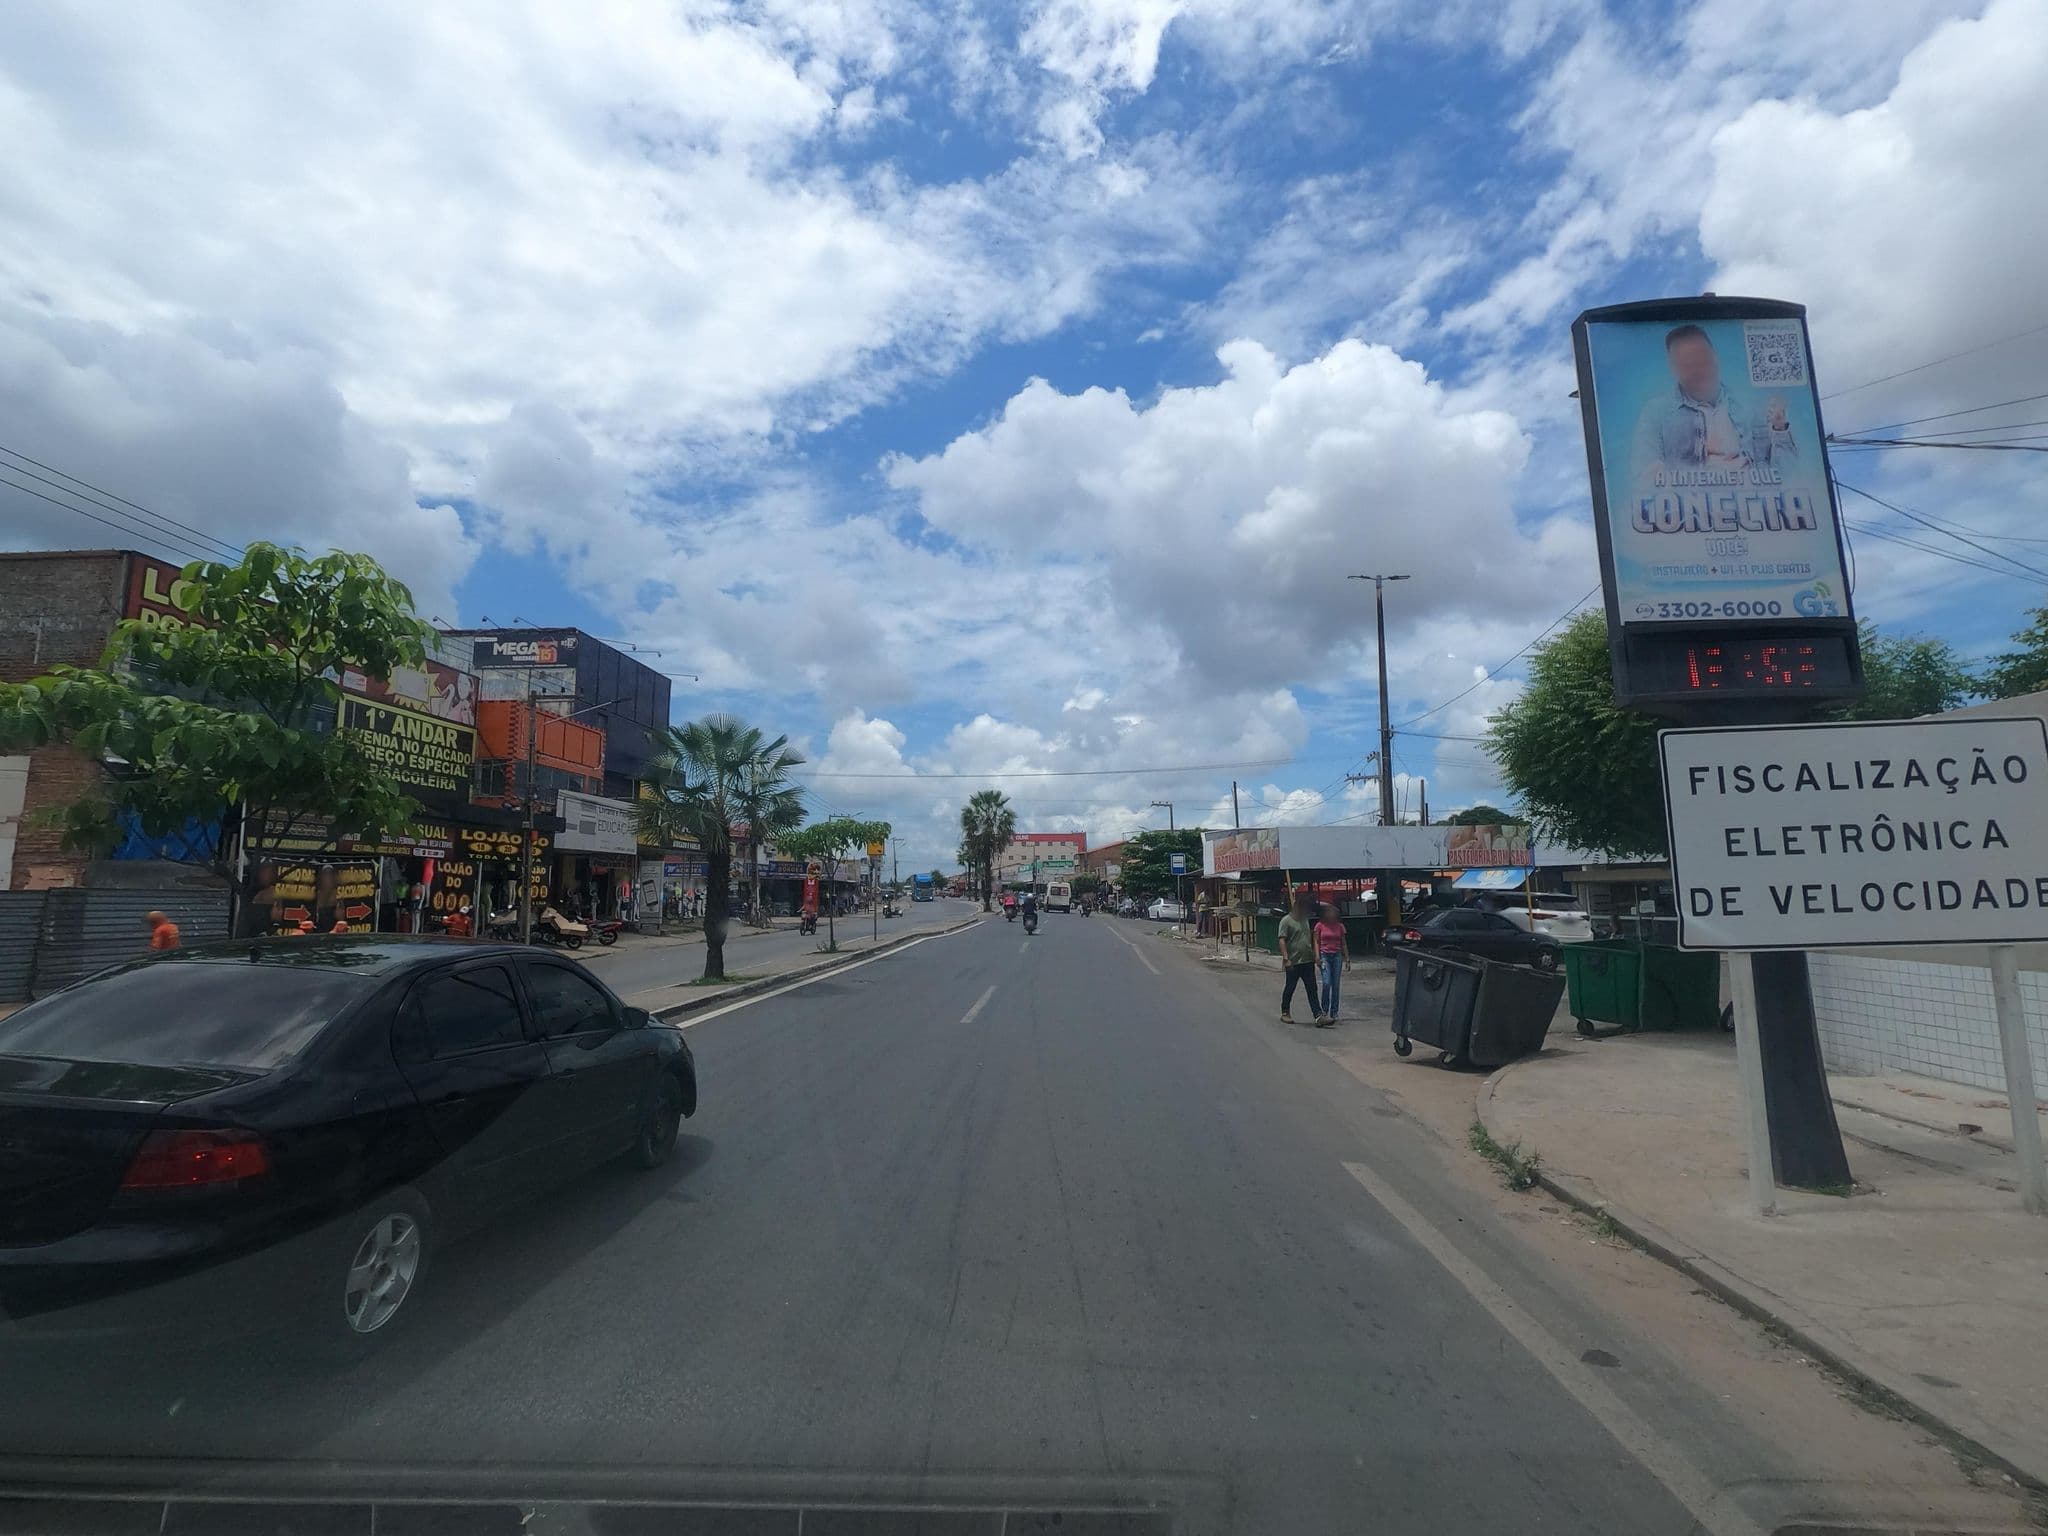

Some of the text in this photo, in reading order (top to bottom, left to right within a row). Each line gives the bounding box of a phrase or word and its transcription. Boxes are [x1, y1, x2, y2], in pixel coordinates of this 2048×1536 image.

[1655, 466, 1783, 487] A INTERNET QUE
[1632, 490, 1817, 534] CONECTA
[1751, 563, 1775, 576] PLUS
[1657, 600, 1782, 619] 3302-6000
[492, 641, 539, 656] MEGA
[391, 715, 458, 749] ANDAR
[402, 738, 420, 755] NO
[422, 746, 471, 766] ATACADO
[409, 754, 468, 778] ESPECIAL
[1689, 748, 2028, 796] FISCALIZAÇÃO
[461, 829, 523, 845] LOJÃO
[1725, 814, 2010, 858] ELETRÔNICA
[437, 861, 473, 876] LOJÃO
[446, 876, 462, 888] DO
[1690, 878, 2048, 917] DE VELOCIDADE
